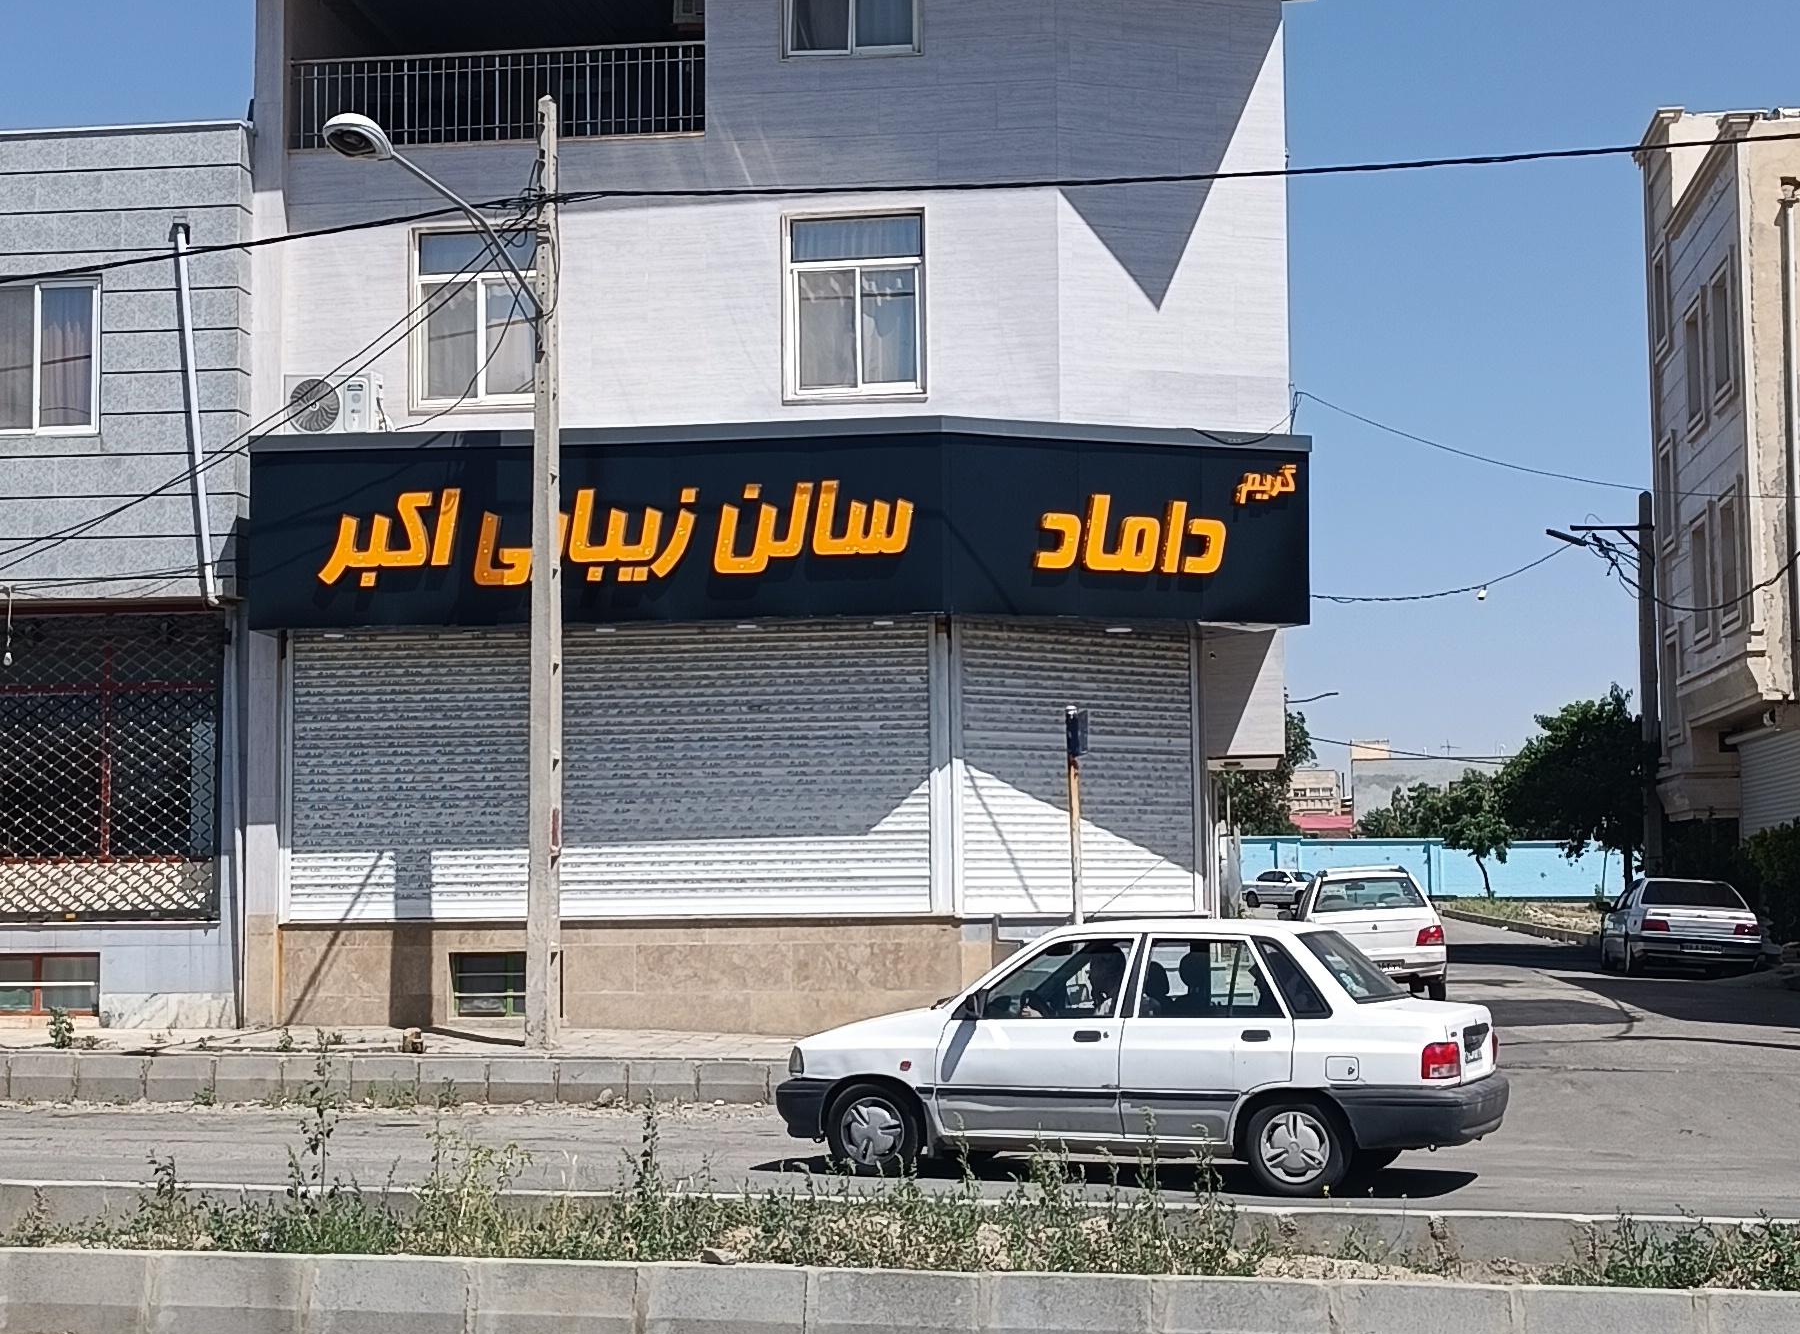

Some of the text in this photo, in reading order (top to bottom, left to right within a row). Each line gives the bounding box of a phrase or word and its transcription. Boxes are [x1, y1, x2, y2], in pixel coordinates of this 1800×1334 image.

[713, 480, 914, 574] سالن
[1236, 464, 1297, 504] گریم
[318, 488, 461, 587] اکبر
[1034, 494, 1227, 574] داماد
